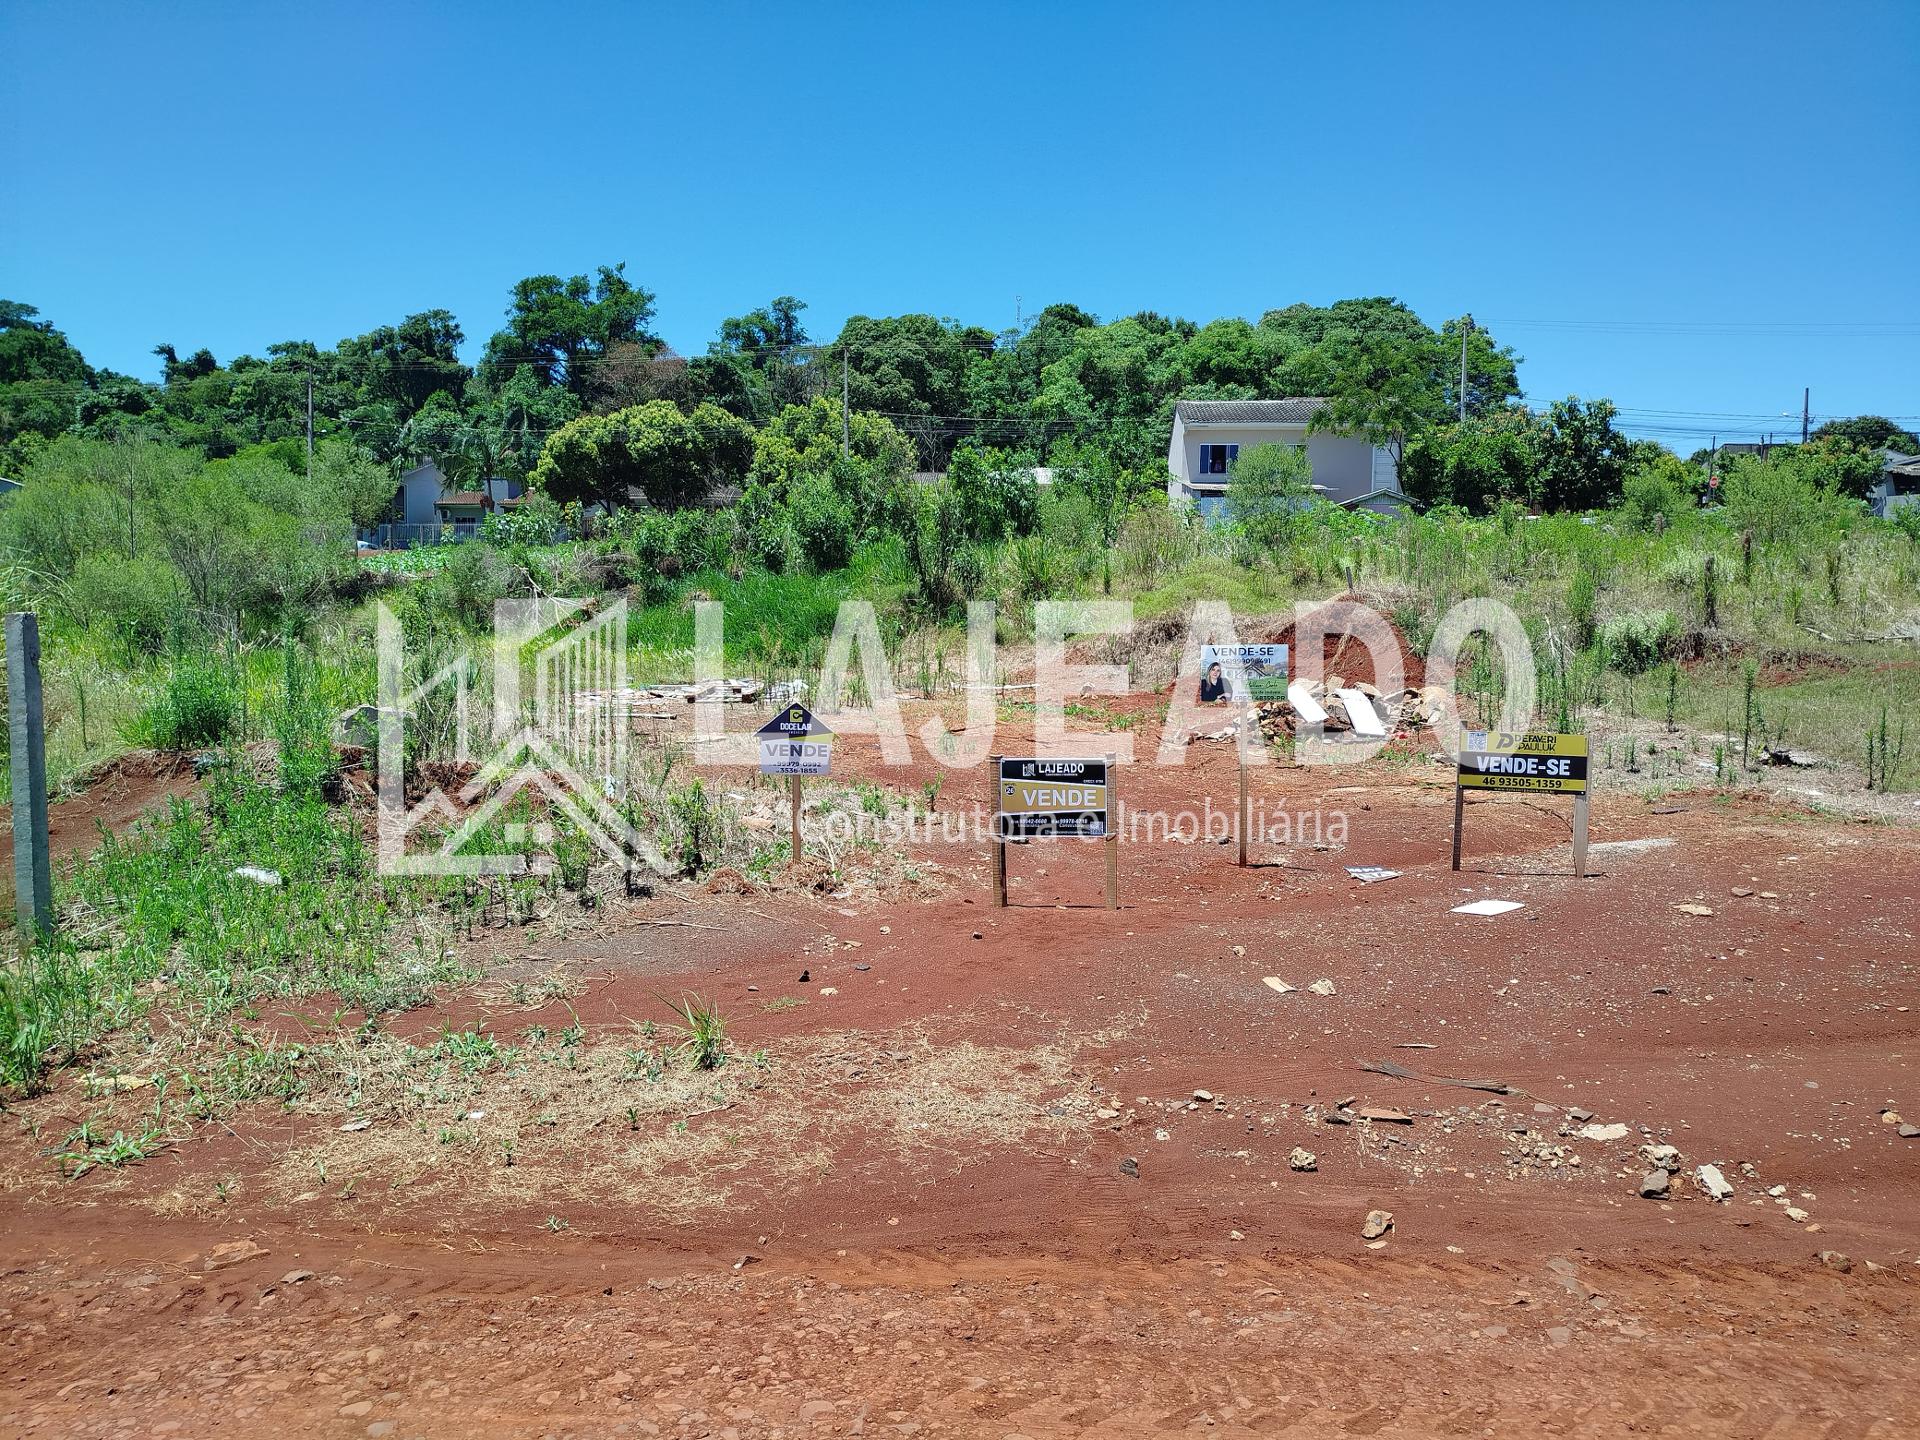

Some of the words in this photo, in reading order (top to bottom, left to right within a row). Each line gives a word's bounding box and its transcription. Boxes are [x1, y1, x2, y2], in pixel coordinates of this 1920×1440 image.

[1211, 646, 1274, 656] VENDE-SE
[1514, 734, 1557, 744] DEFAVERI
[765, 743, 828, 758] VENDE
[1518, 742, 1556, 752] PAULUK
[1038, 762, 1085, 774] LAJEADO
[1476, 756, 1571, 776] VENDE-SE
[1482, 776, 1496, 786] 46
[1498, 777, 1562, 789] 93505-1359
[1022, 789, 1097, 807] VENDE
